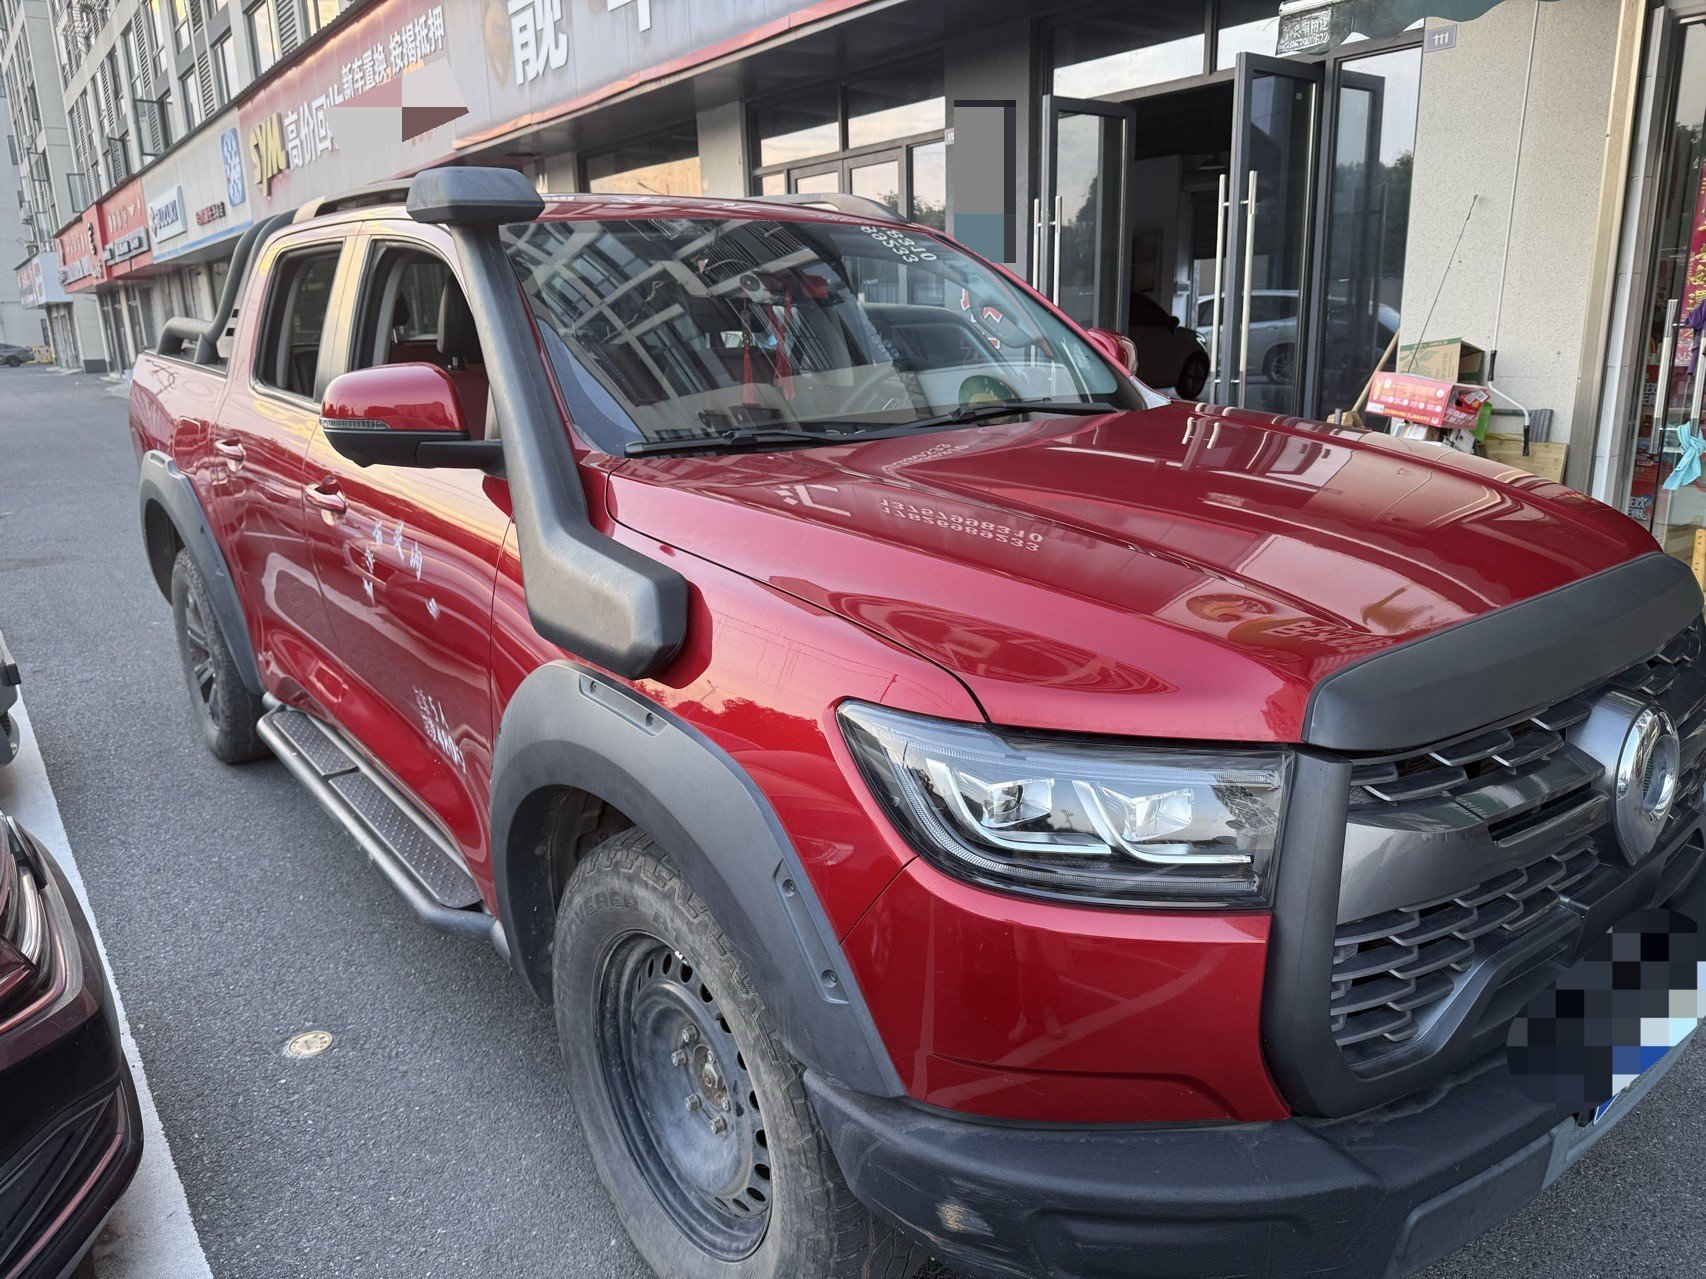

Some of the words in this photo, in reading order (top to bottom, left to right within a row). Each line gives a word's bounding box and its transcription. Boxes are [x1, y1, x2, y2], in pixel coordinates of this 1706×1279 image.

[341, 43, 388, 100] 新车置换
[389, 5, 445, 75] 按揭抵押
[1432, 32, 1450, 46] 111
